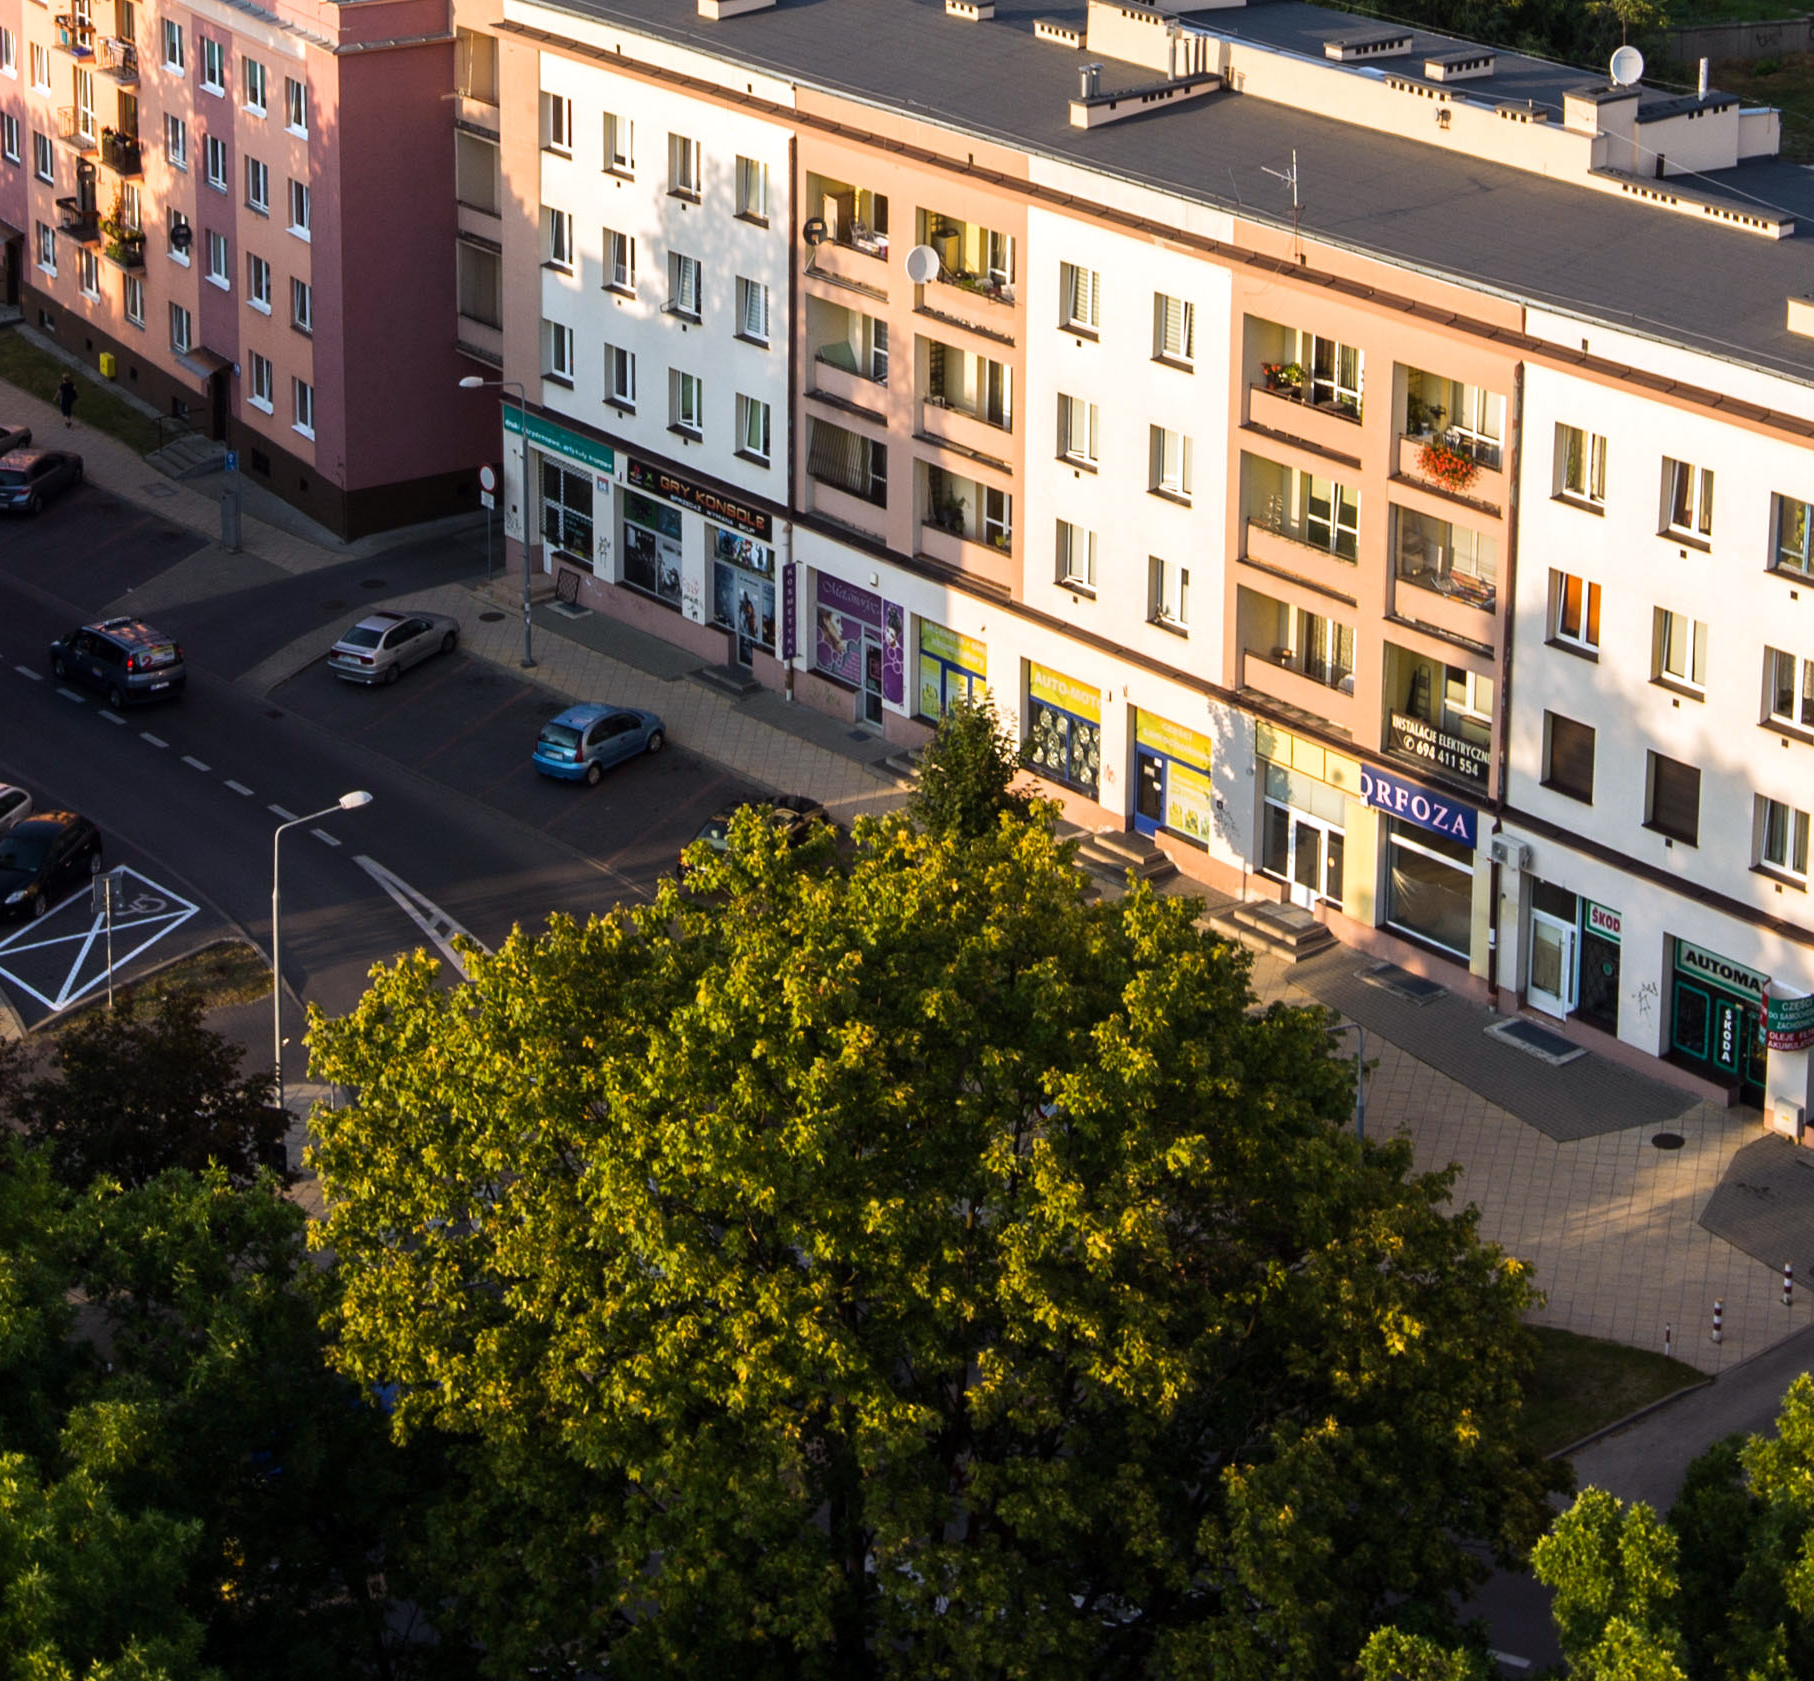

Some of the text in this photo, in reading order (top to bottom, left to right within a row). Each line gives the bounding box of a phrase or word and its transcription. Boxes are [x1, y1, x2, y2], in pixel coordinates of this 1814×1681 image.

[660, 476, 765, 531] GRY KONSOLE
[1391, 713, 1437, 743] INSTALACJE
[1416, 740, 1478, 777] 694 411 554
[1768, 1010, 1779, 1020] DO
[1769, 1031, 1794, 1042] OLEJE
